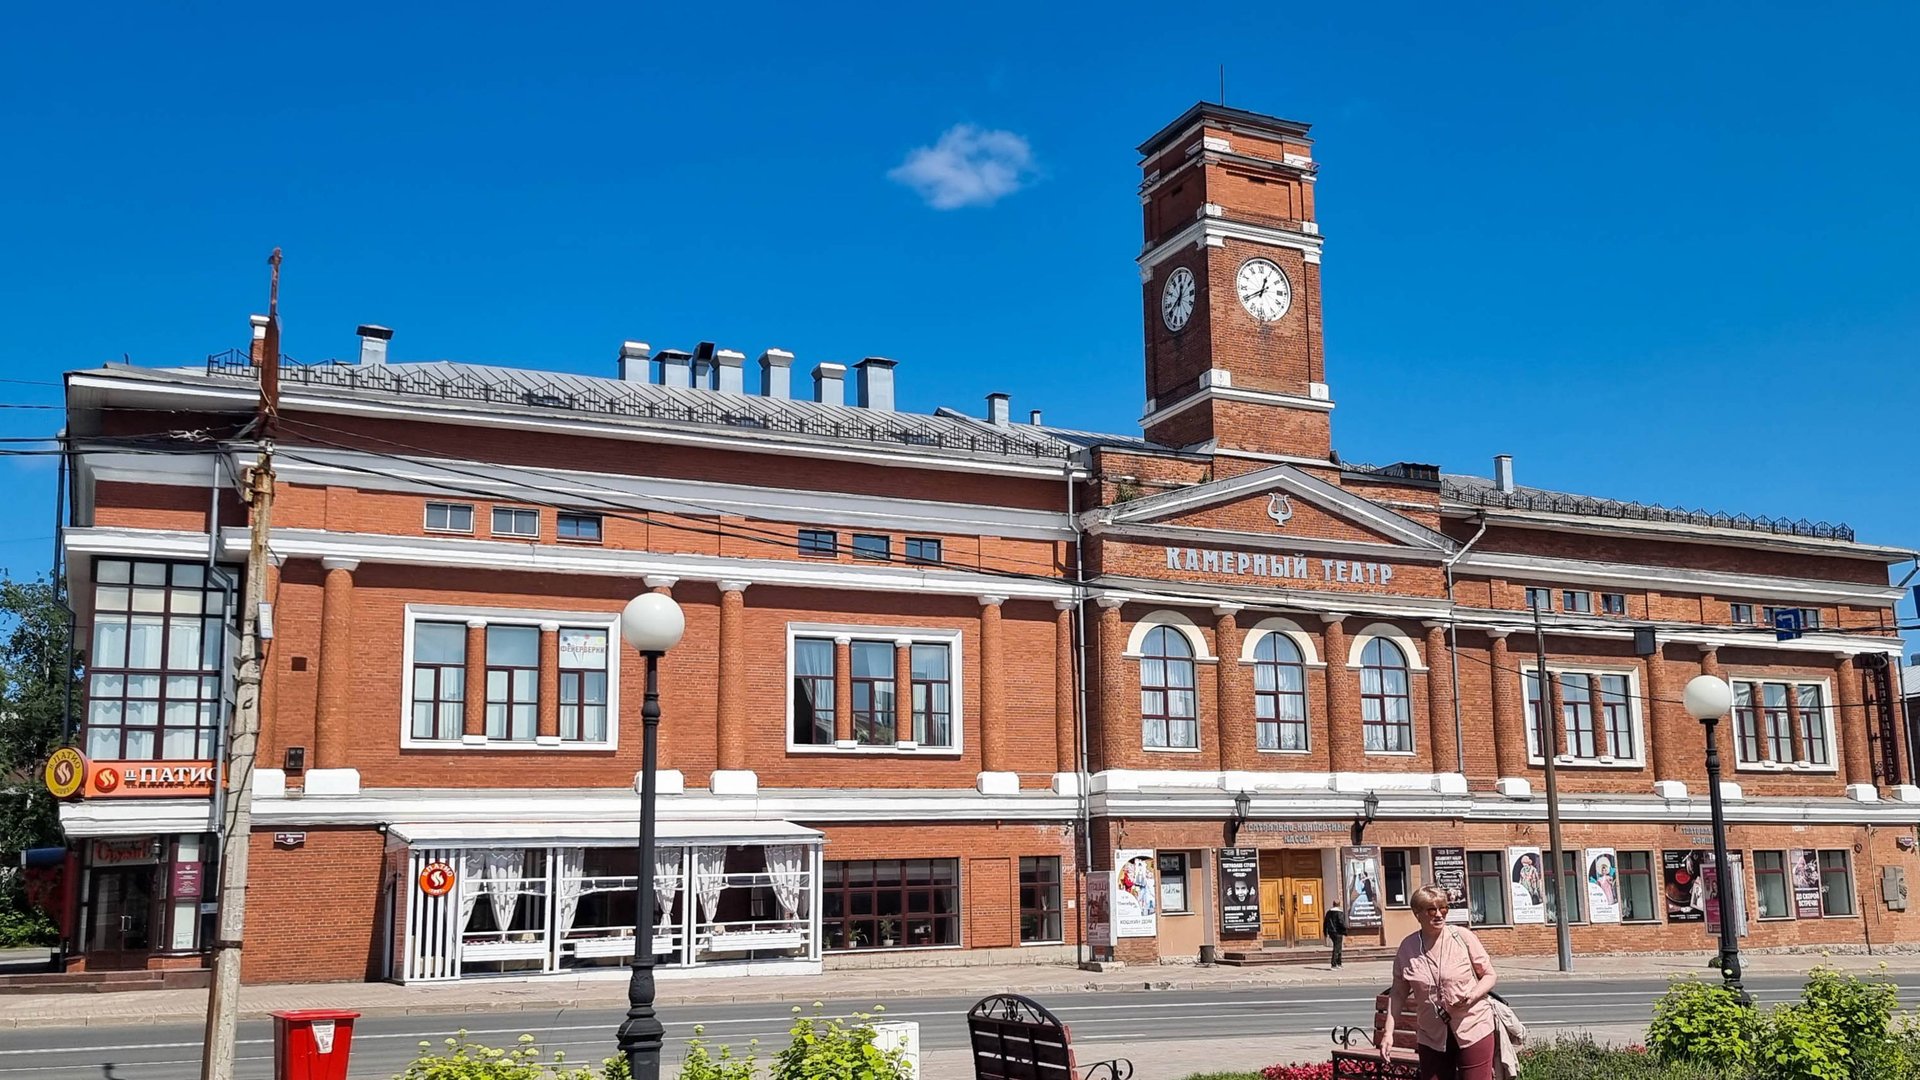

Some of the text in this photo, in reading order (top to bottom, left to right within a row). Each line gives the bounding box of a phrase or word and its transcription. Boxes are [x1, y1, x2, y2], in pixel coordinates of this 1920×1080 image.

[1166, 547, 1393, 585] КАМЕРНЫЙ ТЕАТР
[1692, 837, 1713, 845] АФИШ
